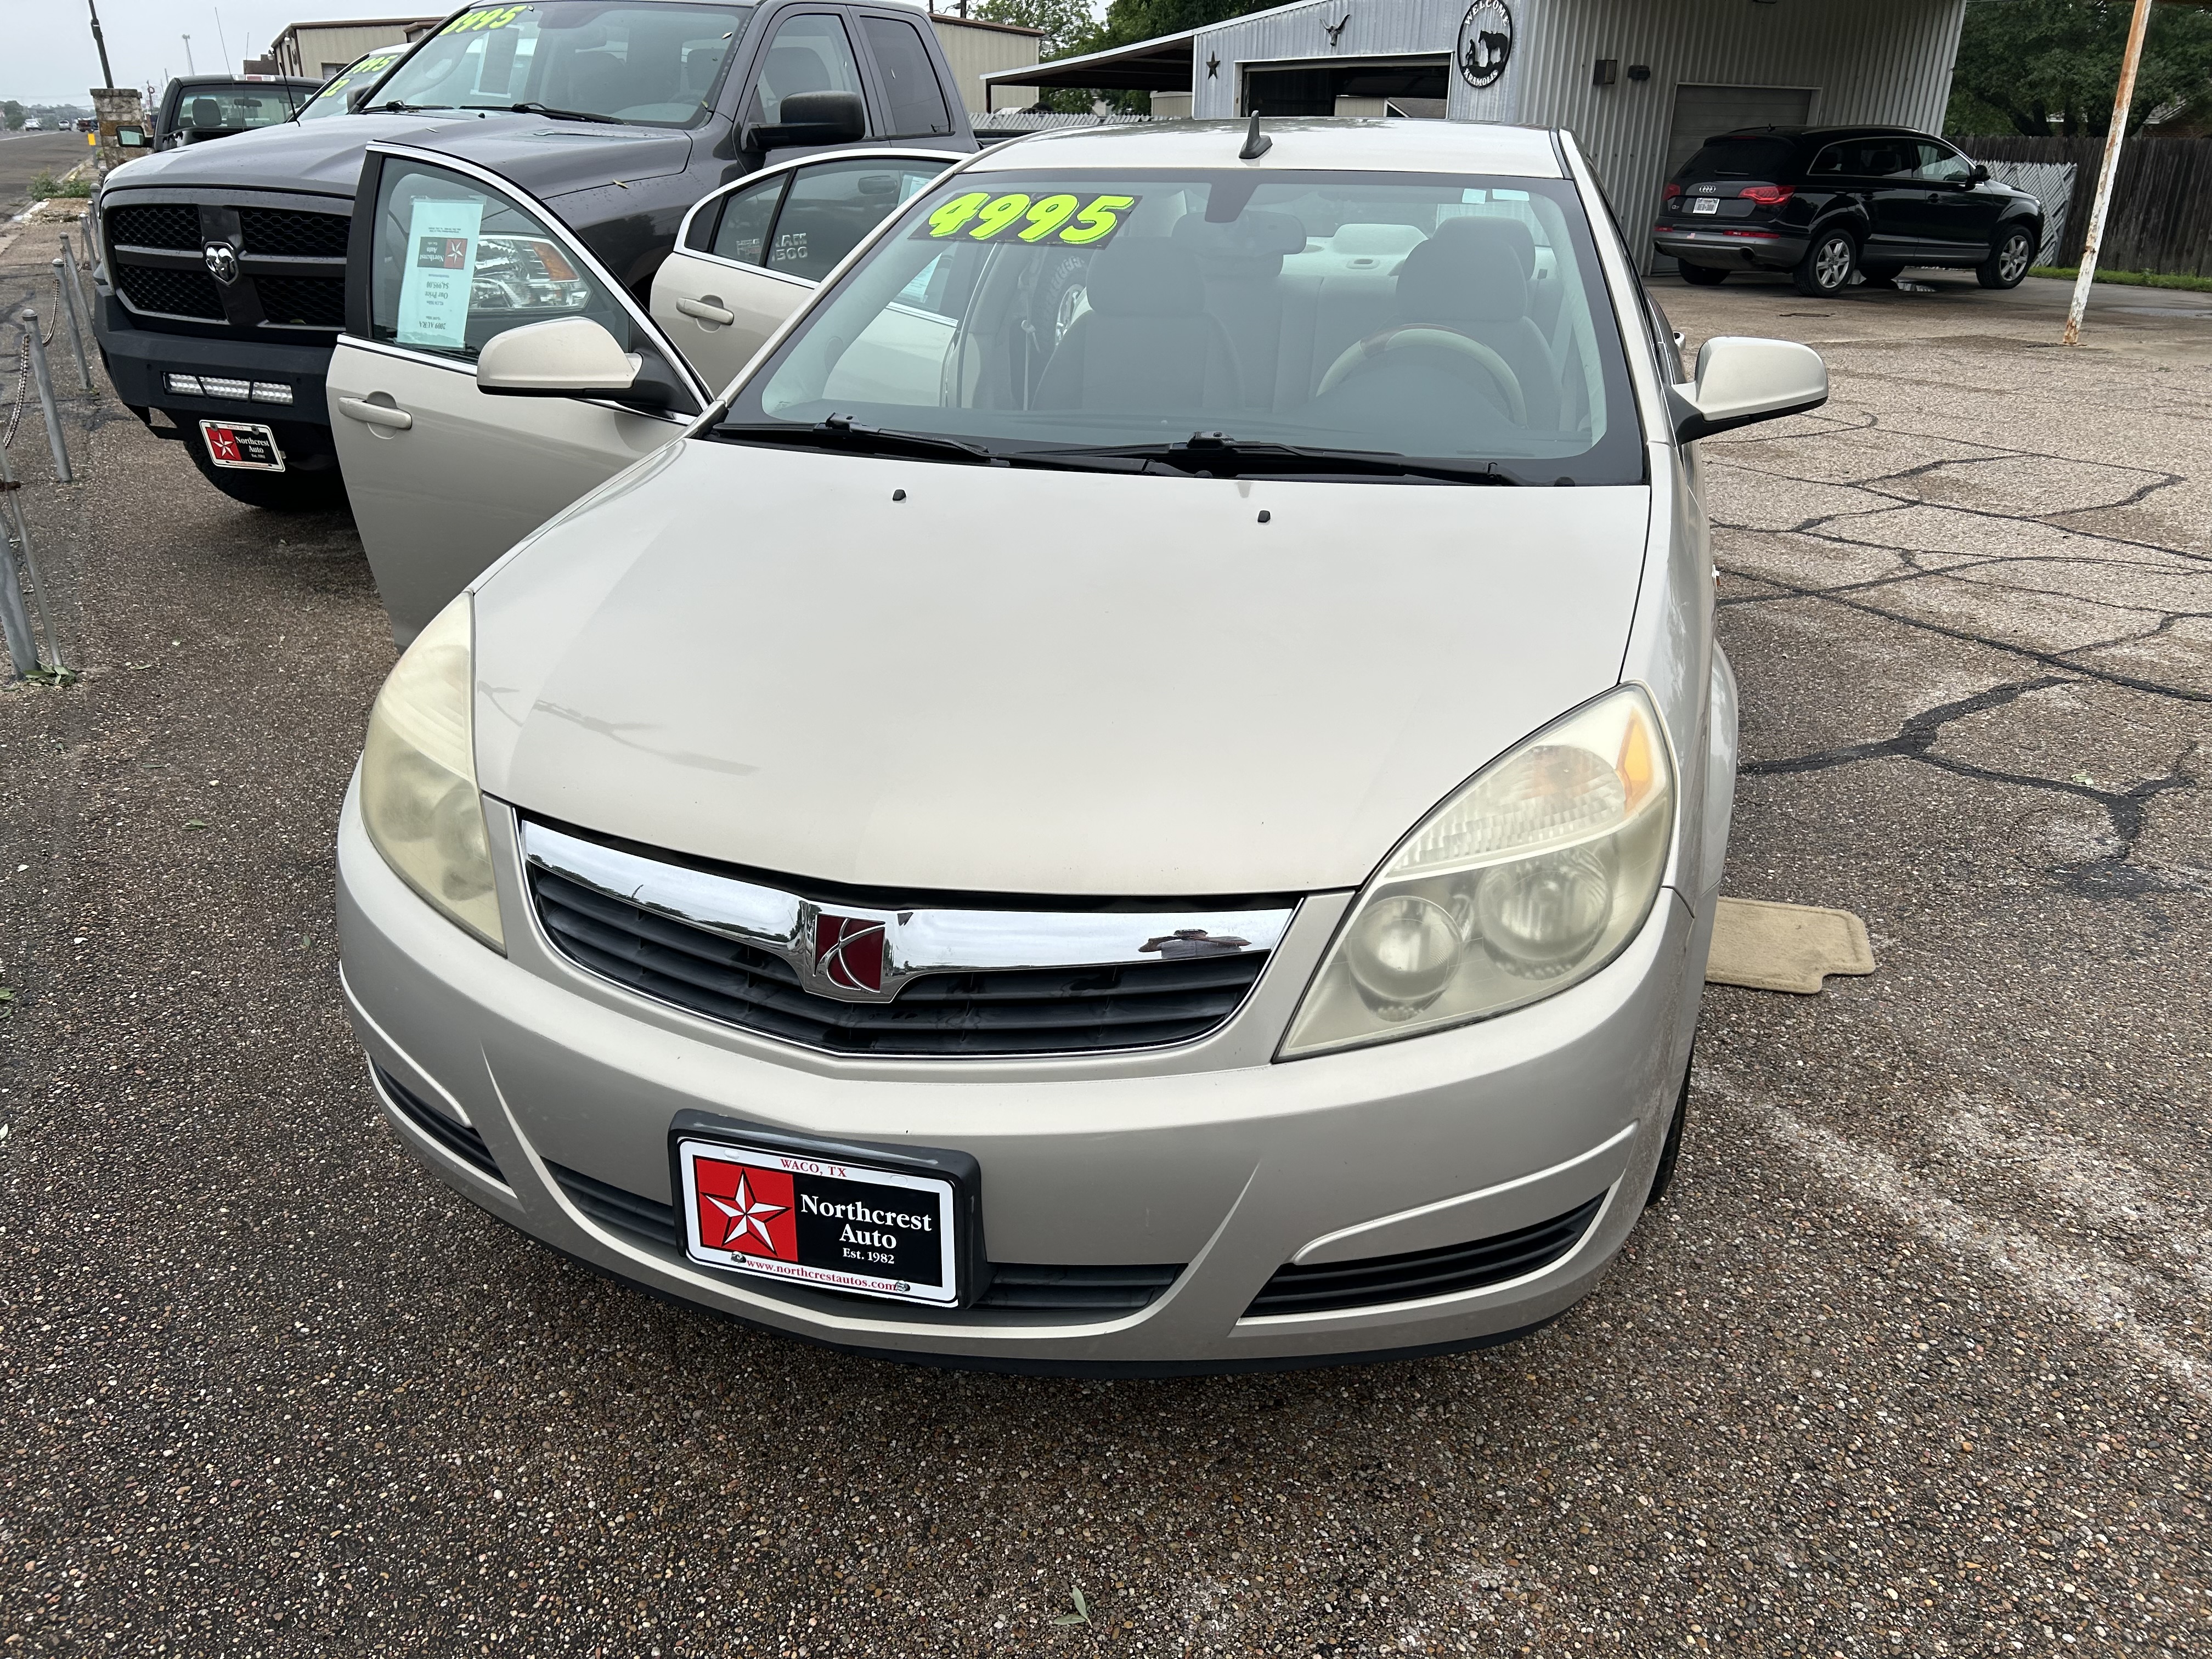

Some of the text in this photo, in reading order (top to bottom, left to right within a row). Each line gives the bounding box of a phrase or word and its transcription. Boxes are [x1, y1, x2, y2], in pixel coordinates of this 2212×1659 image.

[439, 5, 527, 36] 8995
[1465, 0, 1509, 26] WELCOME
[1464, 68, 1499, 86] KRAMOLIS
[928, 193, 1135, 244] 4995
[235, 436, 269, 447] Northcrest
[249, 445, 264, 453] Auto
[780, 1159, 847, 1177] WACO, TX
[800, 1194, 932, 1231] Northcrest
[839, 1223, 897, 1249] Auto
[843, 1248, 895, 1263] Est. 1982
[747, 1260, 897, 1291] www.northcrestautos.com
